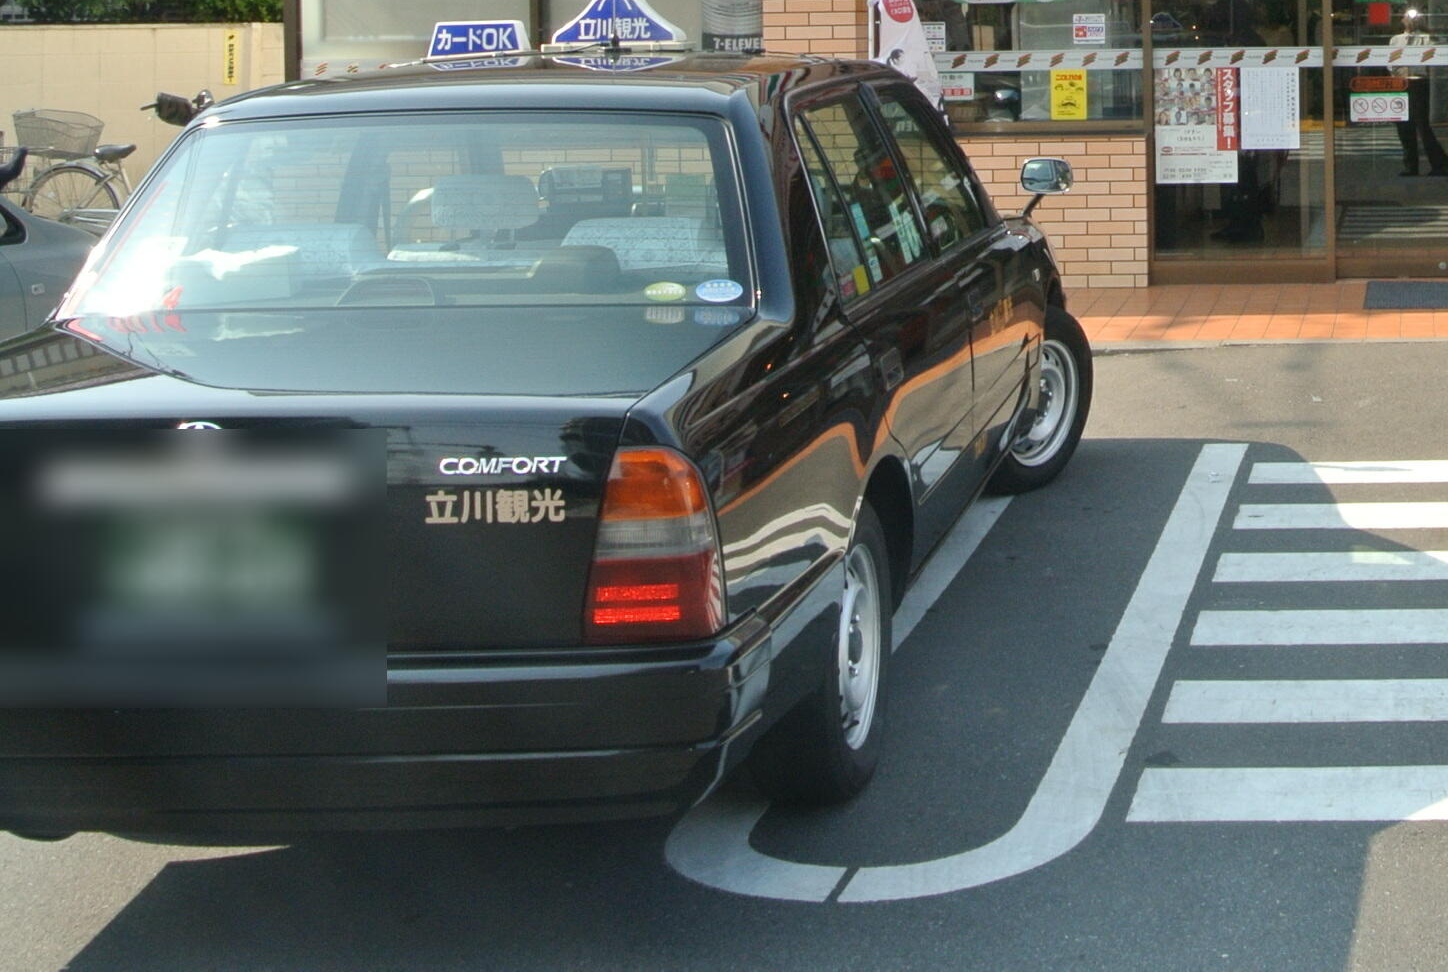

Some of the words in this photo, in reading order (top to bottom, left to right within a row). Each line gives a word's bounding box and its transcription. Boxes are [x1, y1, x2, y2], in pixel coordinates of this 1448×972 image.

[437, 28, 514, 51] カードOK
[579, 17, 651, 40] 立川観光
[439, 456, 568, 475] COMFORT
[425, 488, 566, 524] 立川観光
